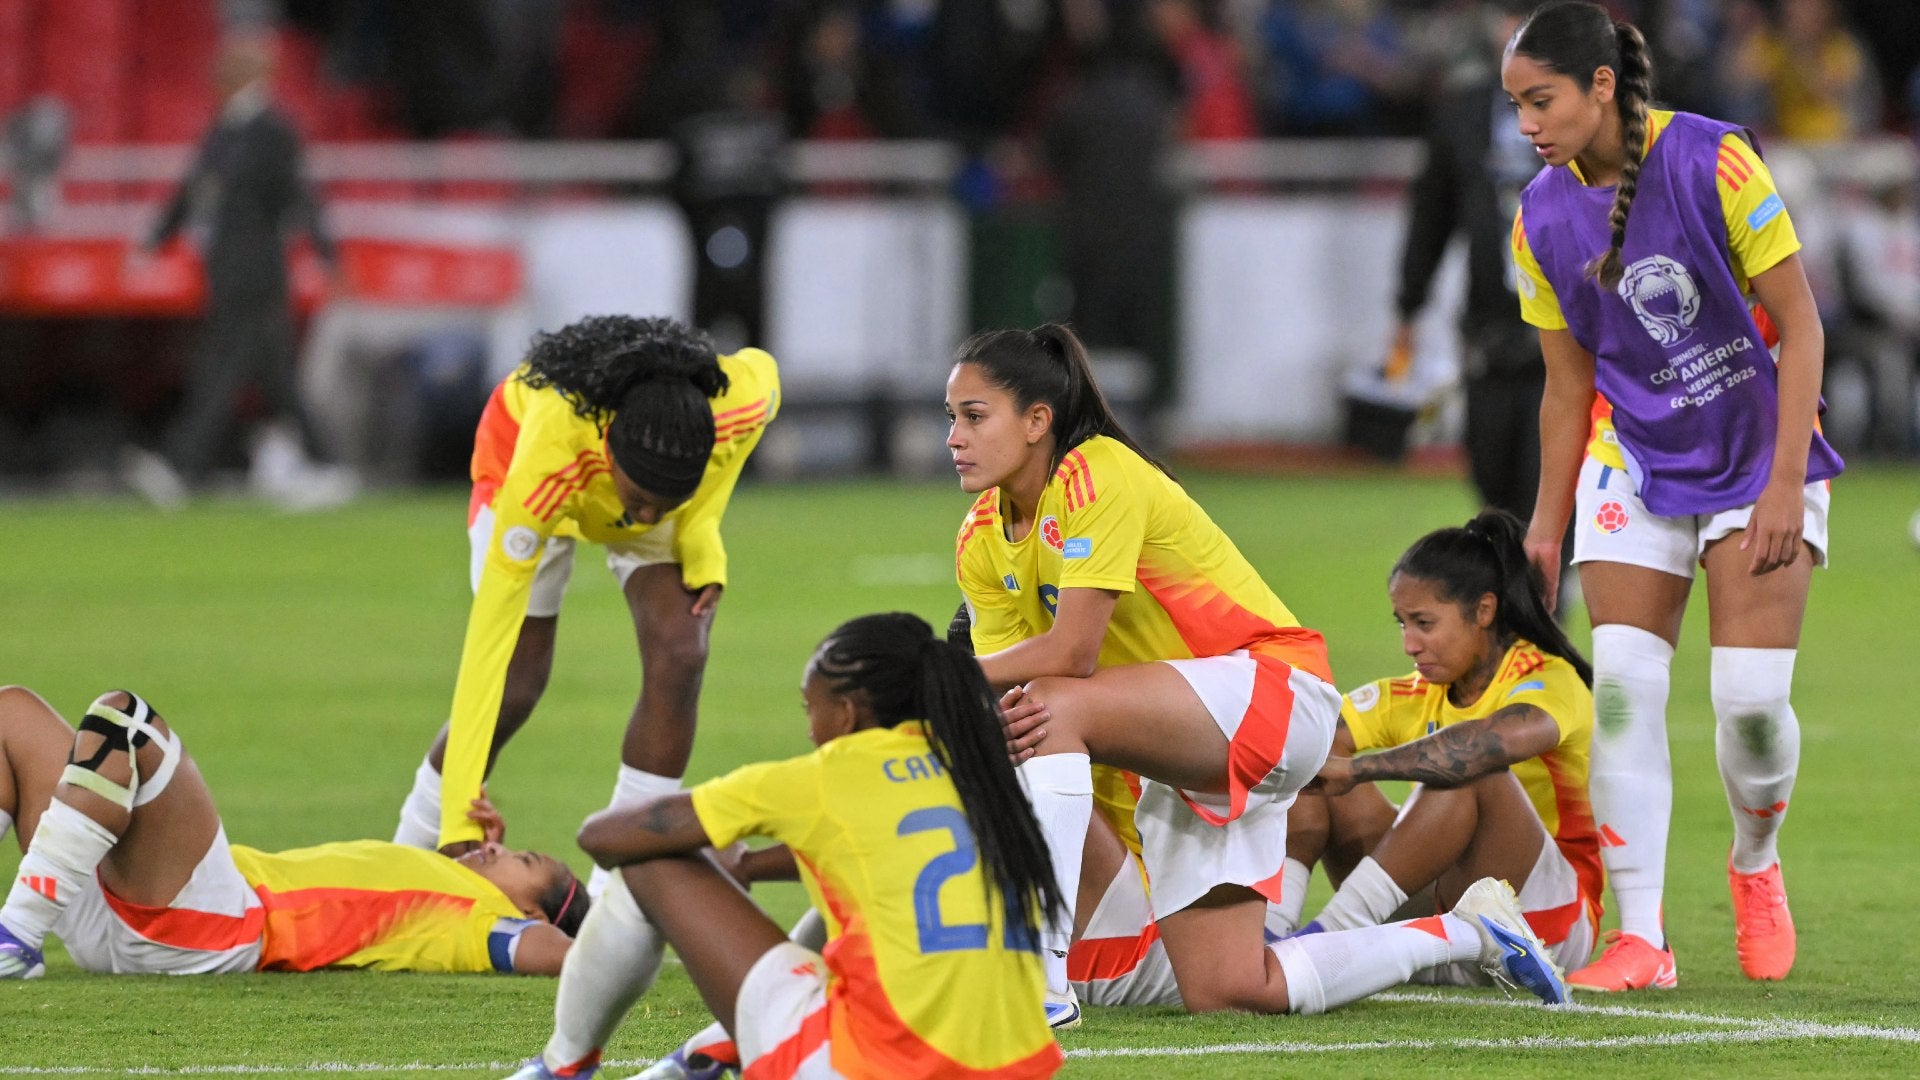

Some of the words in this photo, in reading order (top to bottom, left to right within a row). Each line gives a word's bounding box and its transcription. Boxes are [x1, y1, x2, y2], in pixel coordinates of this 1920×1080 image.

[1668, 343, 1707, 367] CONMEBOL
[1680, 336, 1754, 382] AMERICA
[1670, 383, 1724, 408] ECUDOR
[1725, 366, 1757, 388] 2025
